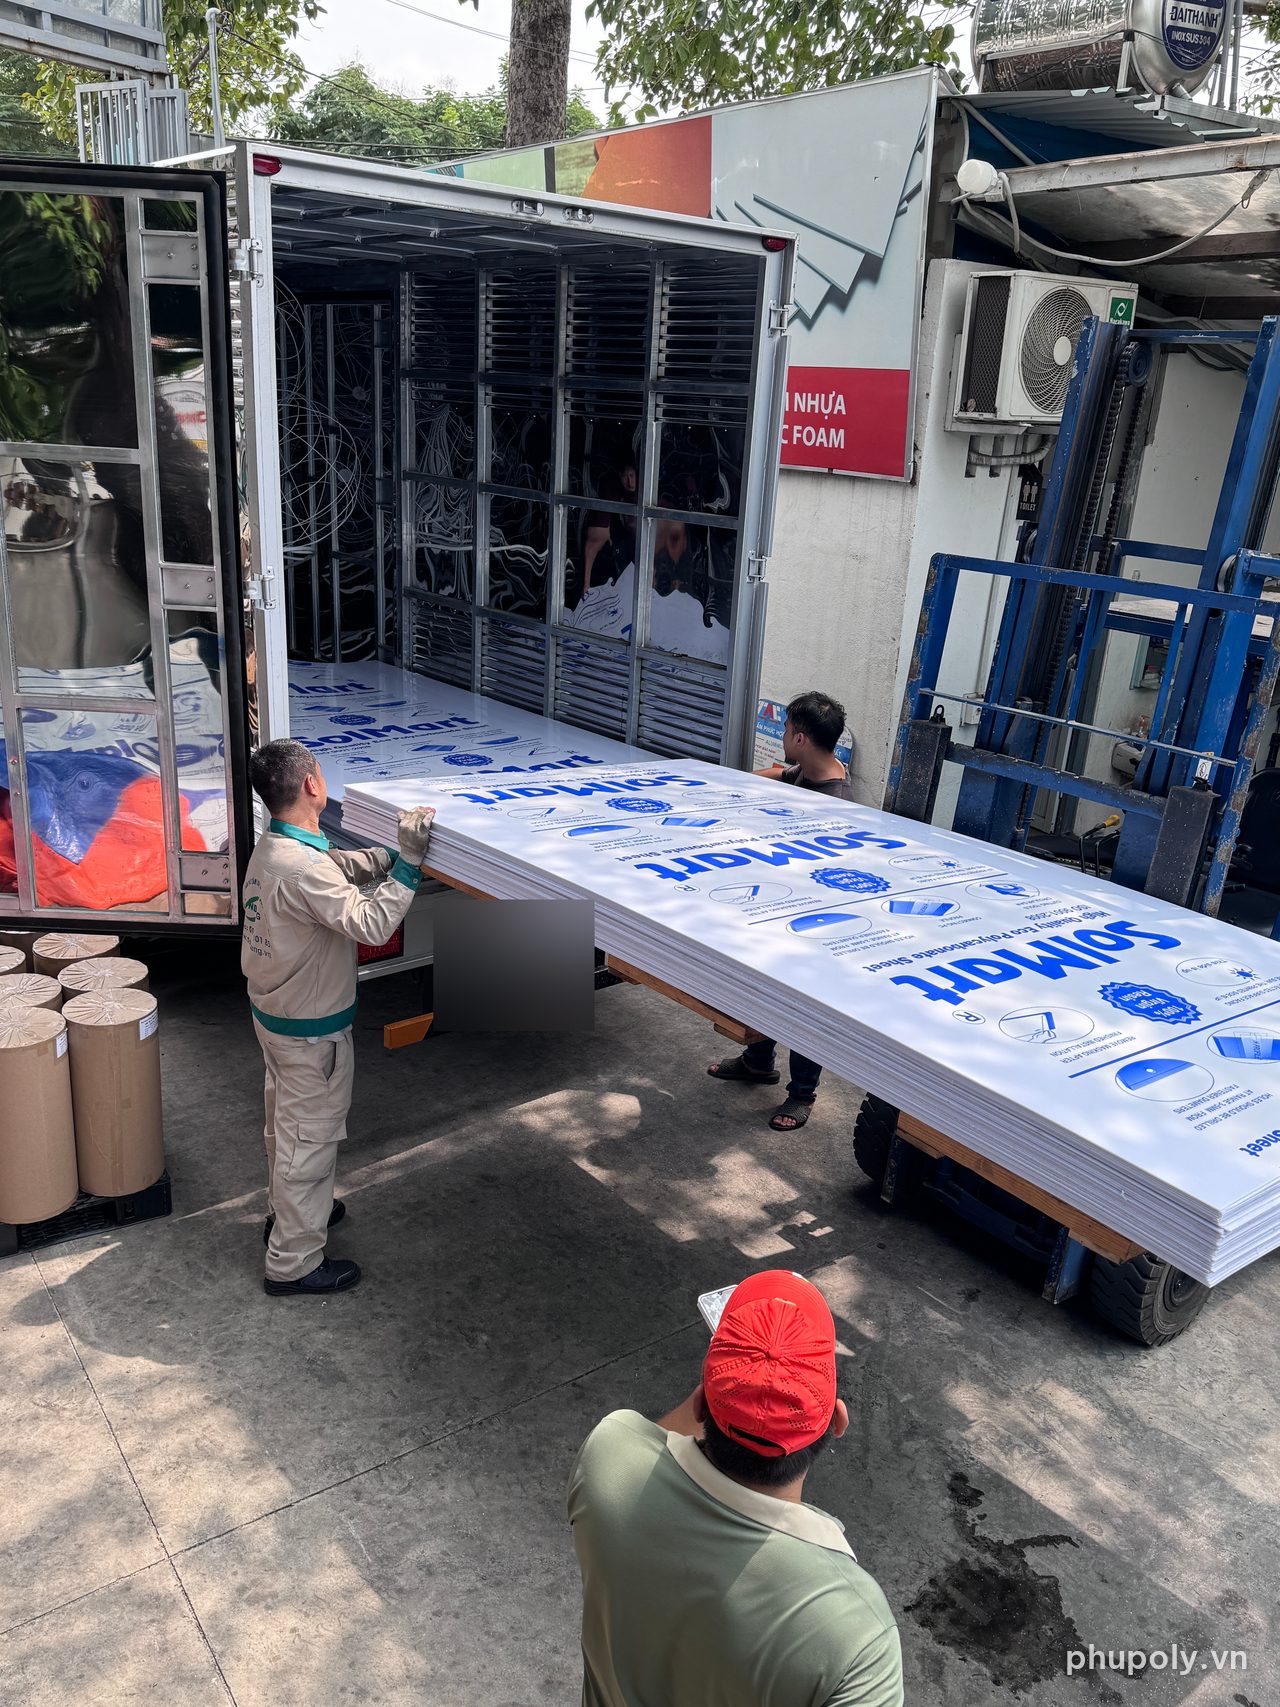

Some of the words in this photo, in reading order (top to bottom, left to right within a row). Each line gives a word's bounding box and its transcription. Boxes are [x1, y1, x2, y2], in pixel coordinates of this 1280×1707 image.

[793, 390, 846, 420] NHỰA
[793, 425, 845, 449] FOAM
[1020, 502, 1036, 511] TOILET
[452, 775, 707, 805] SolMart
[634, 831, 907, 882] SolMart
[1079, 911, 1111, 920] High
[1034, 917, 1082, 929] Quality
[1010, 926, 1039, 935] Eco
[912, 933, 1013, 959] Polycarbonate
[863, 957, 913, 972] Sheet
[889, 920, 1181, 1005] SolMart
[1119, 990, 1152, 1001] Resin
[1135, 997, 1169, 1009] Virgin
[1154, 1005, 1184, 1017] 100%
[1228, 1102, 1255, 1115] SHOULD
[1194, 1117, 1222, 1131] DRILLED
